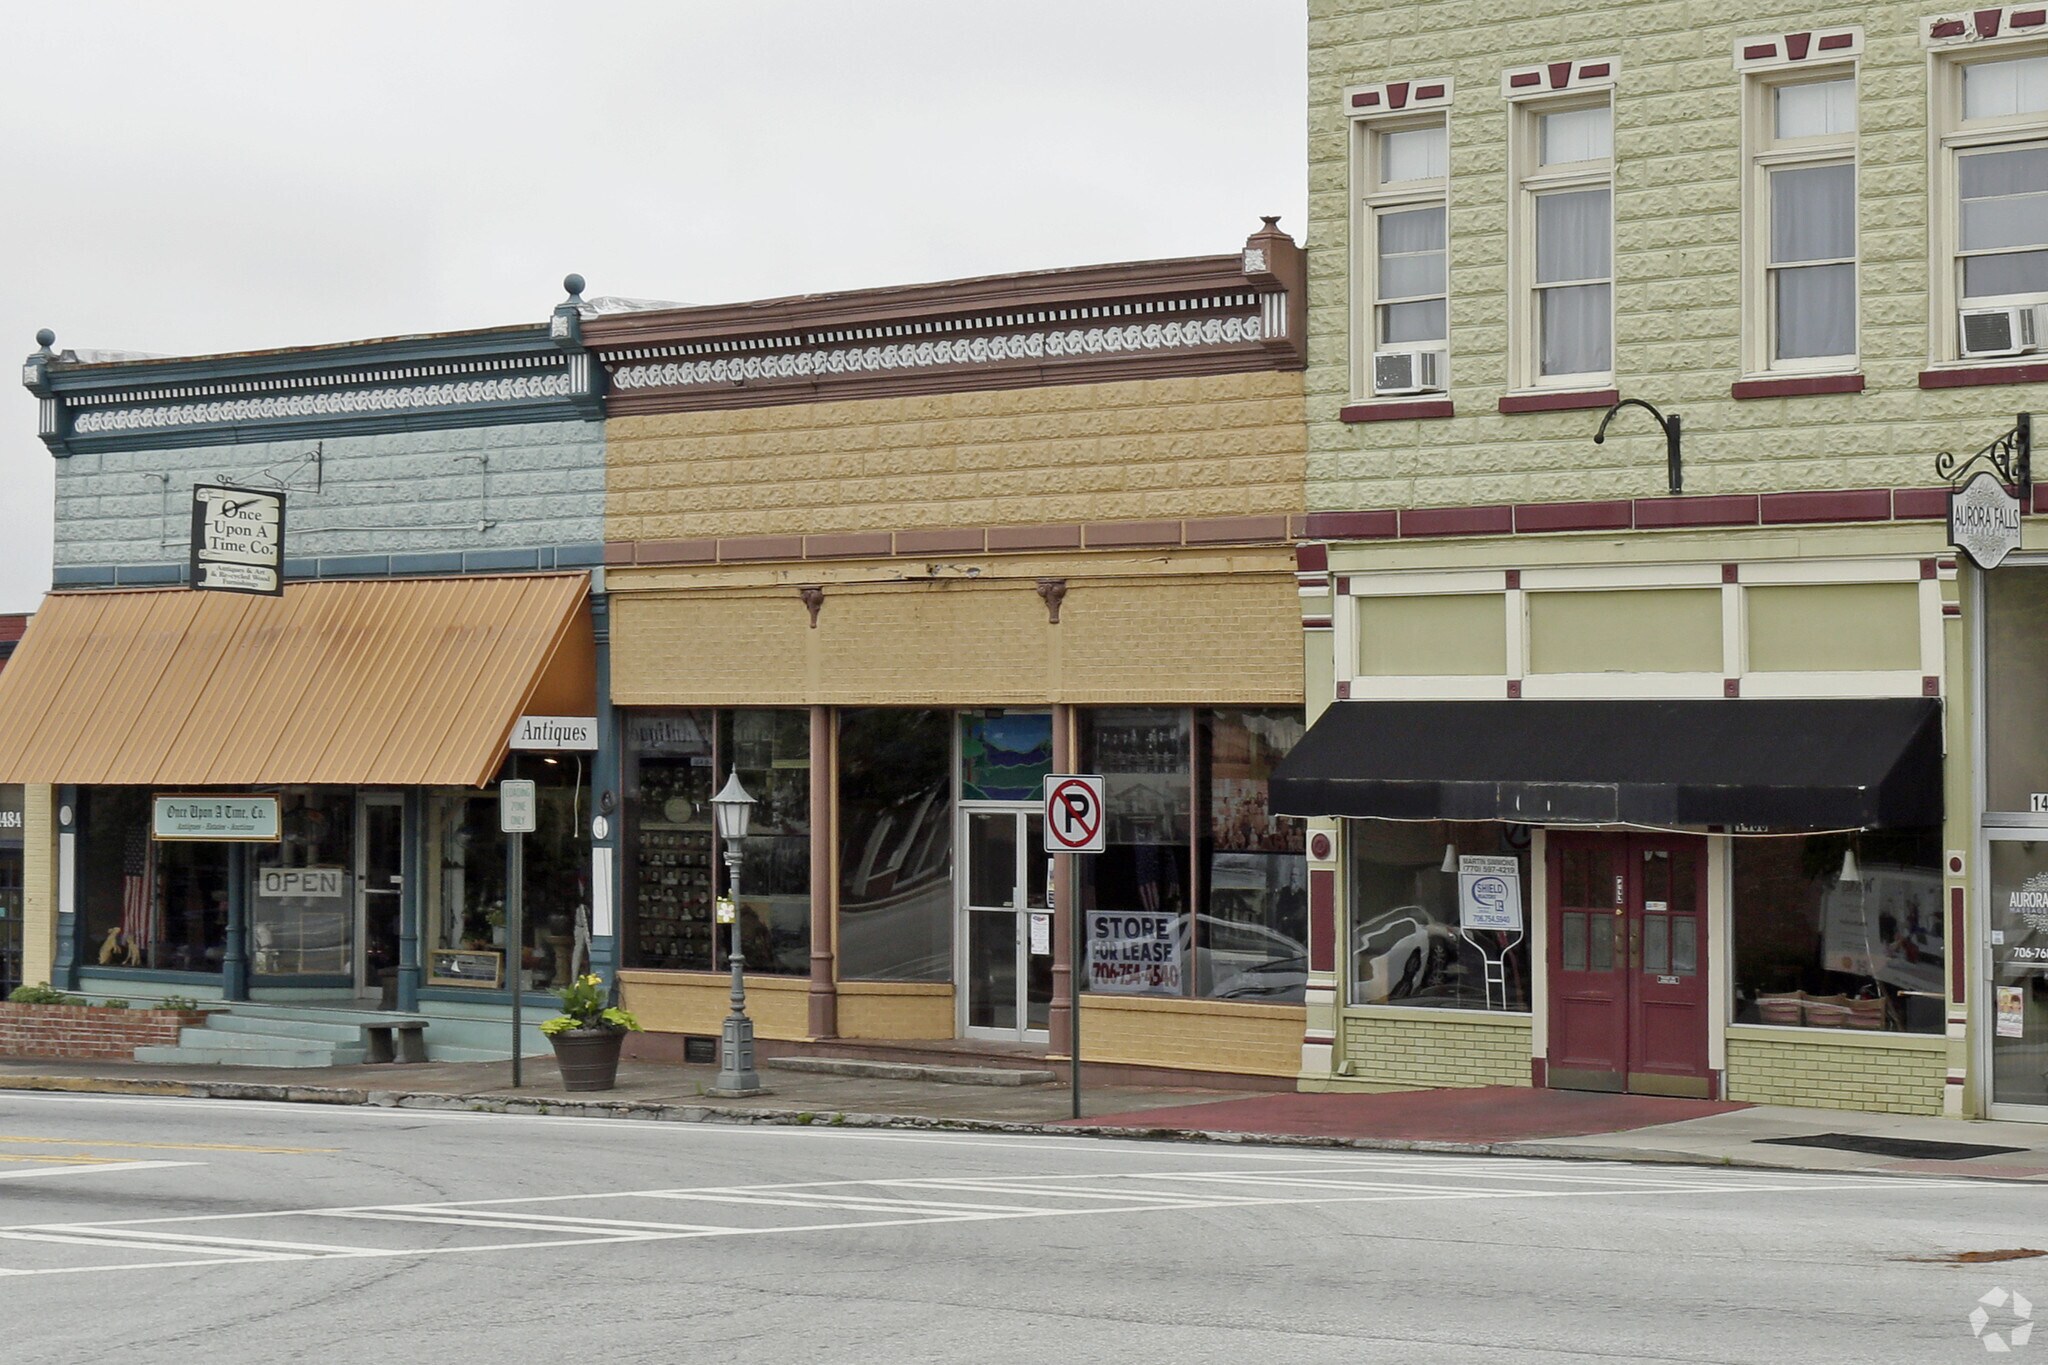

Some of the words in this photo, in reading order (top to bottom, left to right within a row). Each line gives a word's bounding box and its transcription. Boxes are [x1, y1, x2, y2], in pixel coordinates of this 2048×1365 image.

[221, 499, 262, 520] Once
[1954, 505, 1991, 528] AURORA
[1994, 507, 2019, 530] FALLS
[214, 520, 252, 537] Upon
[256, 525, 268, 538] A
[250, 540, 274, 555] Co.
[522, 720, 587, 747] Antiques
[0, 811, 22, 828] 484
[266, 873, 337, 892] OPEN
[1477, 883, 1503, 893] SHIELD
[1095, 916, 1170, 940] STORE
[1092, 942, 1118, 960] FOR
[1123, 942, 1174, 962] LEASE
[2013, 947, 2048, 958] 706-76
